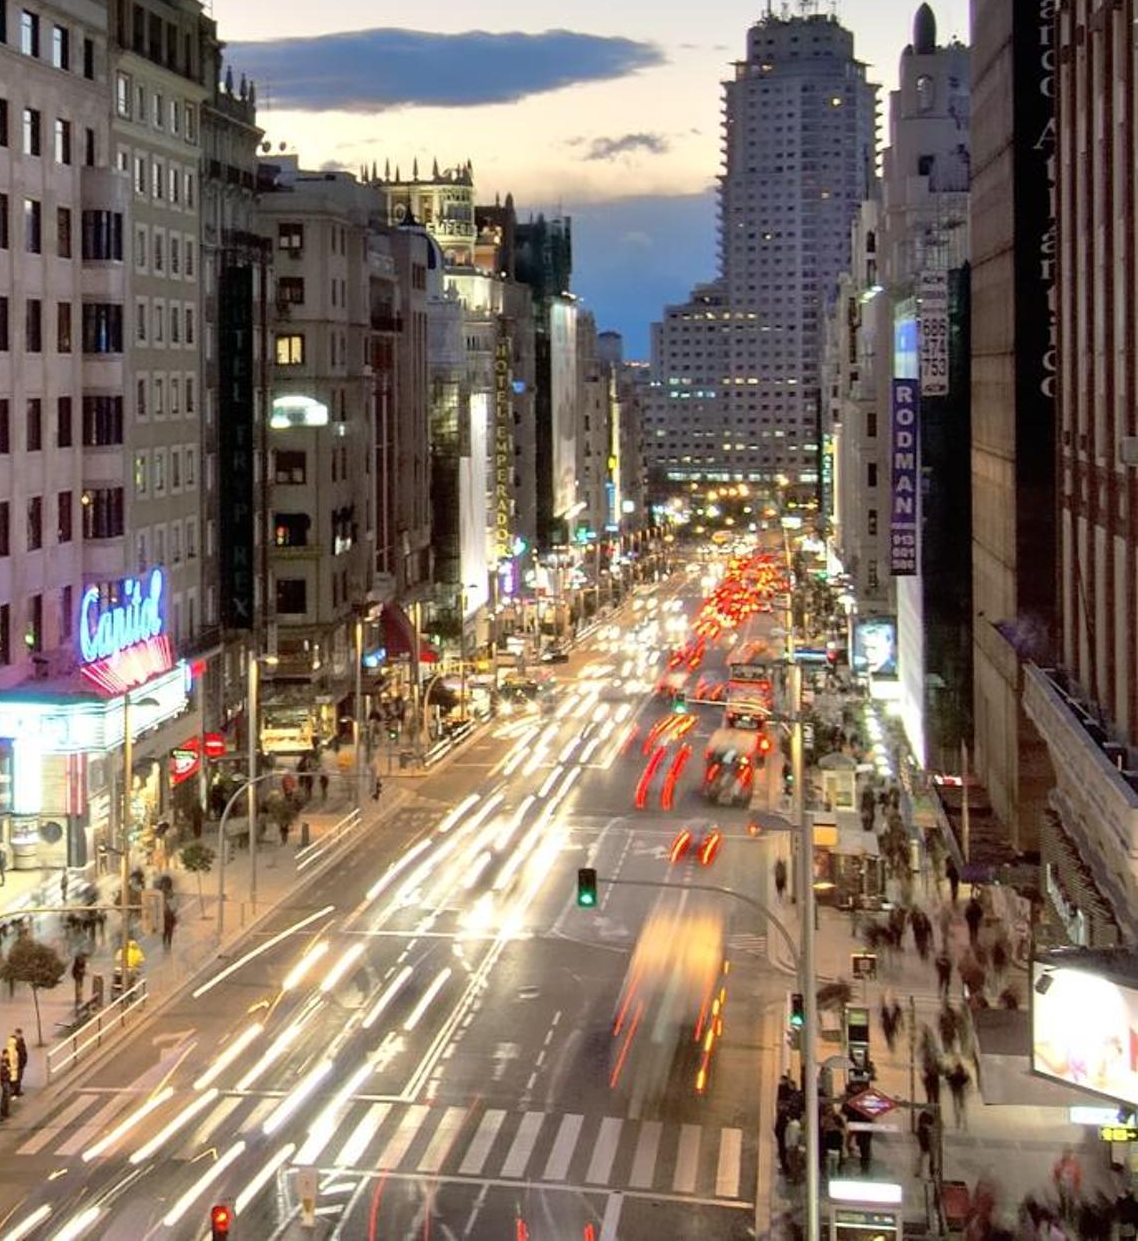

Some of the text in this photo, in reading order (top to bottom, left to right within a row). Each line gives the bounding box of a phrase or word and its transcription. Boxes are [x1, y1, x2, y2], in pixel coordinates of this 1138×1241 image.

[495, 344, 508, 418] HOTEL
[923, 358, 946, 376] 753
[895, 385, 915, 514] RODMAN
[80, 569, 163, 663] Capitol
